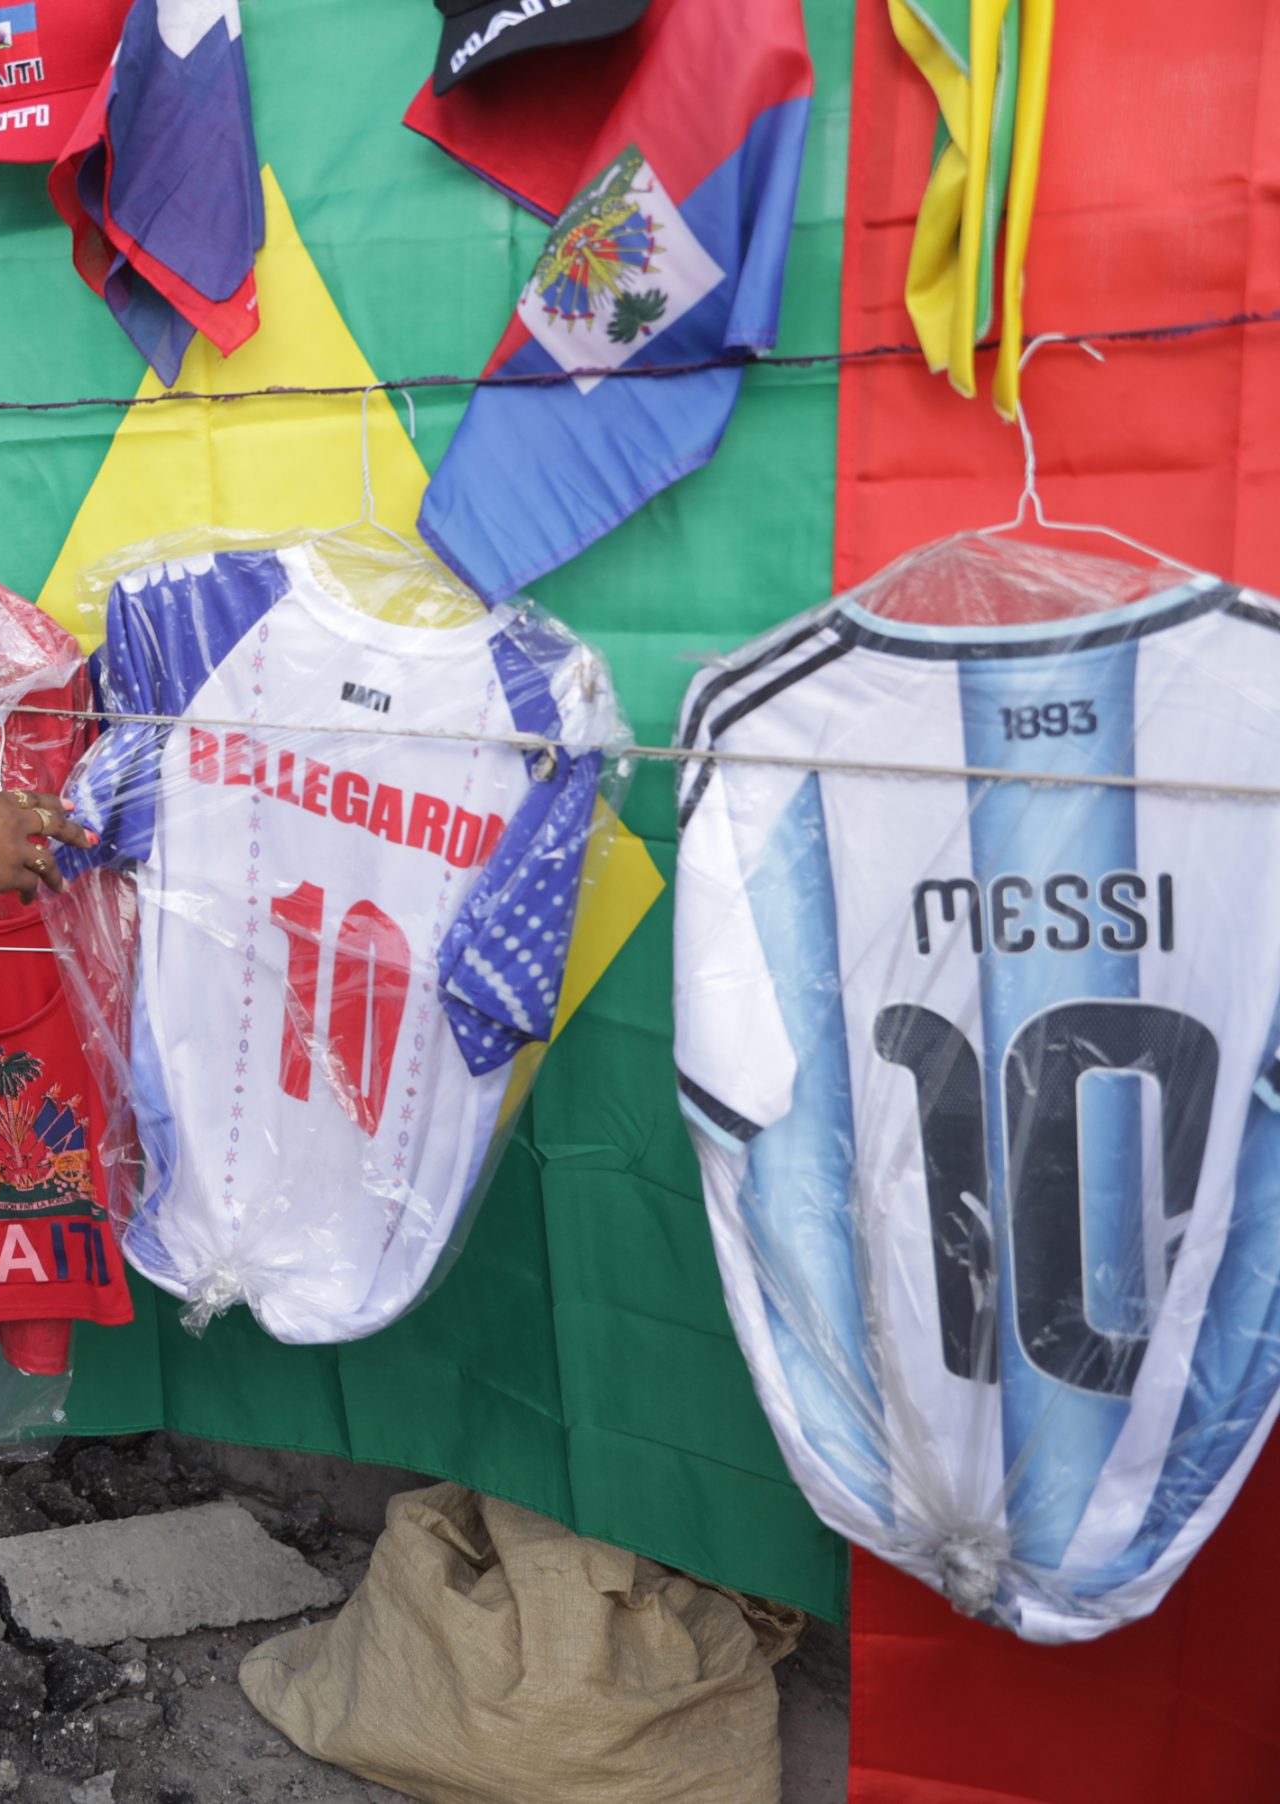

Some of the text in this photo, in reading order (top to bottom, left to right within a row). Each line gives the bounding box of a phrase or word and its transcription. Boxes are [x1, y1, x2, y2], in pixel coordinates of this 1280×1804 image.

[450, 0, 572, 74] HAI
[340, 681, 392, 714] HAITI
[998, 699, 1098, 741] 1893
[912, 870, 1175, 957] MESSI
[270, 879, 412, 1139] 10
[872, 996, 1220, 1398] 10
